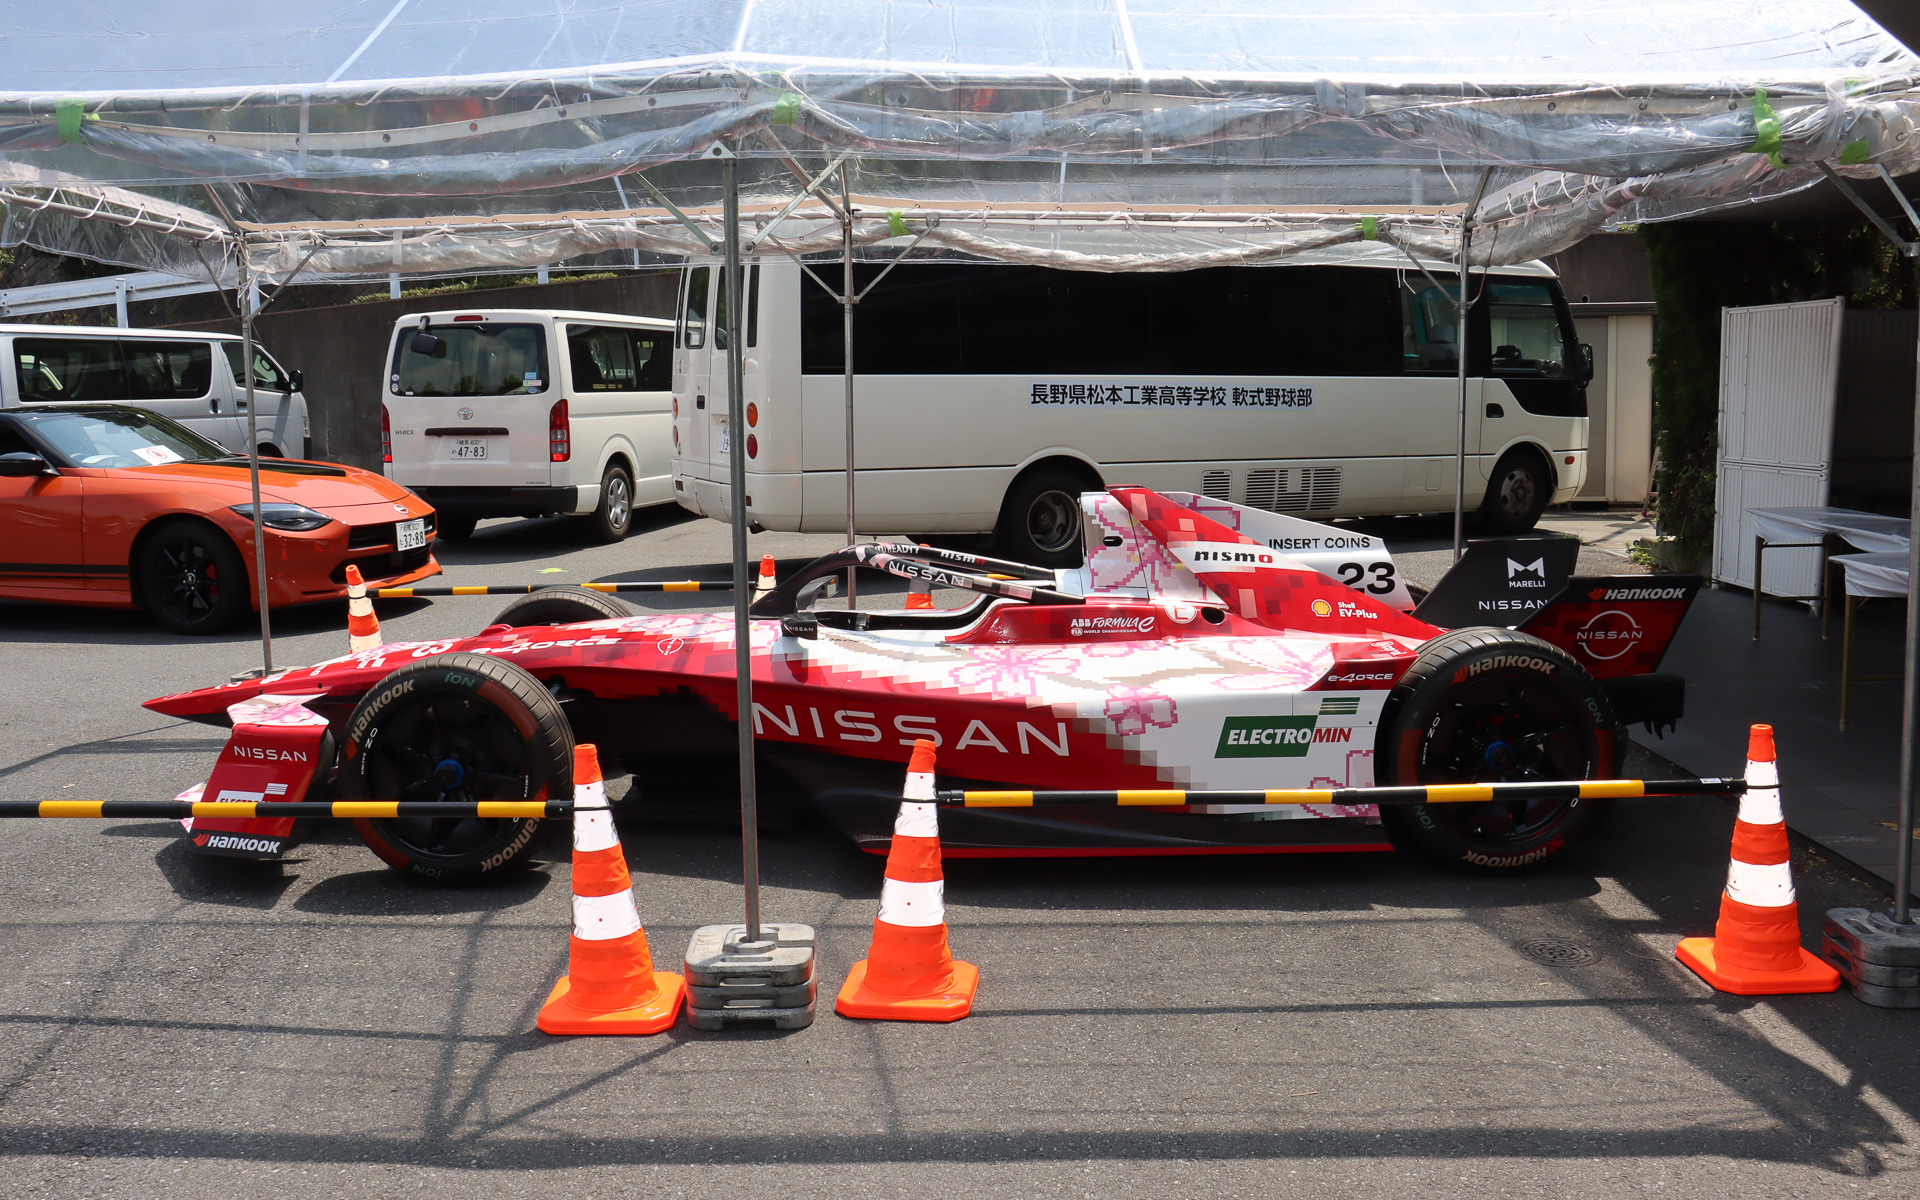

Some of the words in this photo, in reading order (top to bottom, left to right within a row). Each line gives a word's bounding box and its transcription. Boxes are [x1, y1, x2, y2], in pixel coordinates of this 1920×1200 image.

[1031, 384, 1227, 406] 長野県松本工業高等学校
[1232, 387, 1313, 408] 軟式野球部
[457, 446, 485, 457] 47-83
[403, 531, 424, 548] 32-88
[1269, 538, 1321, 549] INSERT
[1324, 537, 1371, 548] COINS
[888, 560, 965, 586] NISSAN
[1337, 561, 1396, 594] 23
[1508, 580, 1546, 588] MARELLI
[1337, 601, 1356, 609] Shell
[1478, 600, 1548, 610] NISSAN
[1338, 608, 1378, 619] EV-Plus
[1070, 618, 1091, 627] ABB
[1091, 616, 1140, 628] FORMULA
[1576, 630, 1643, 640] NISSAN
[752, 702, 1070, 757] NISSAN
[1227, 727, 1352, 745] ELECTROMIN
[233, 745, 307, 762] NISSAN
